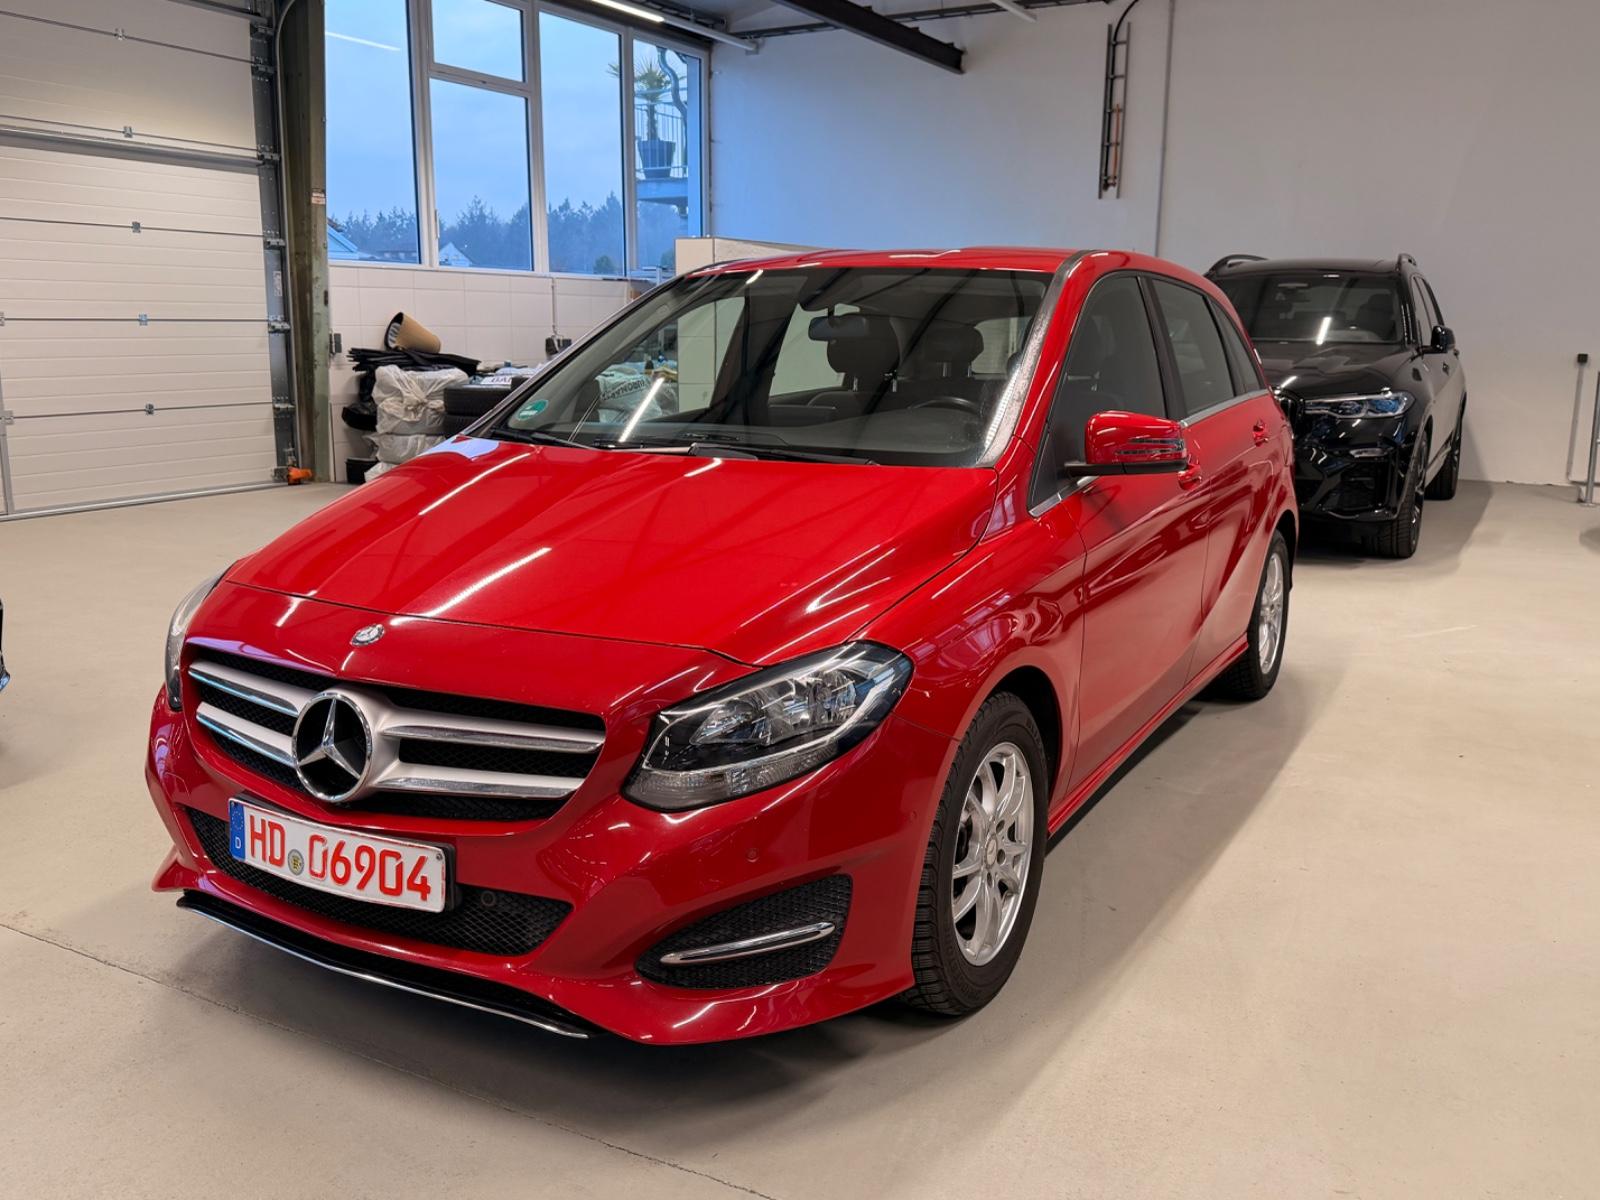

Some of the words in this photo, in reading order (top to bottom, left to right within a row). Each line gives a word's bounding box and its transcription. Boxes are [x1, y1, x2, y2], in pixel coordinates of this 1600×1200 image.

[235, 837, 241, 849] D
[250, 815, 285, 867] HD
[308, 834, 431, 901] 06904
